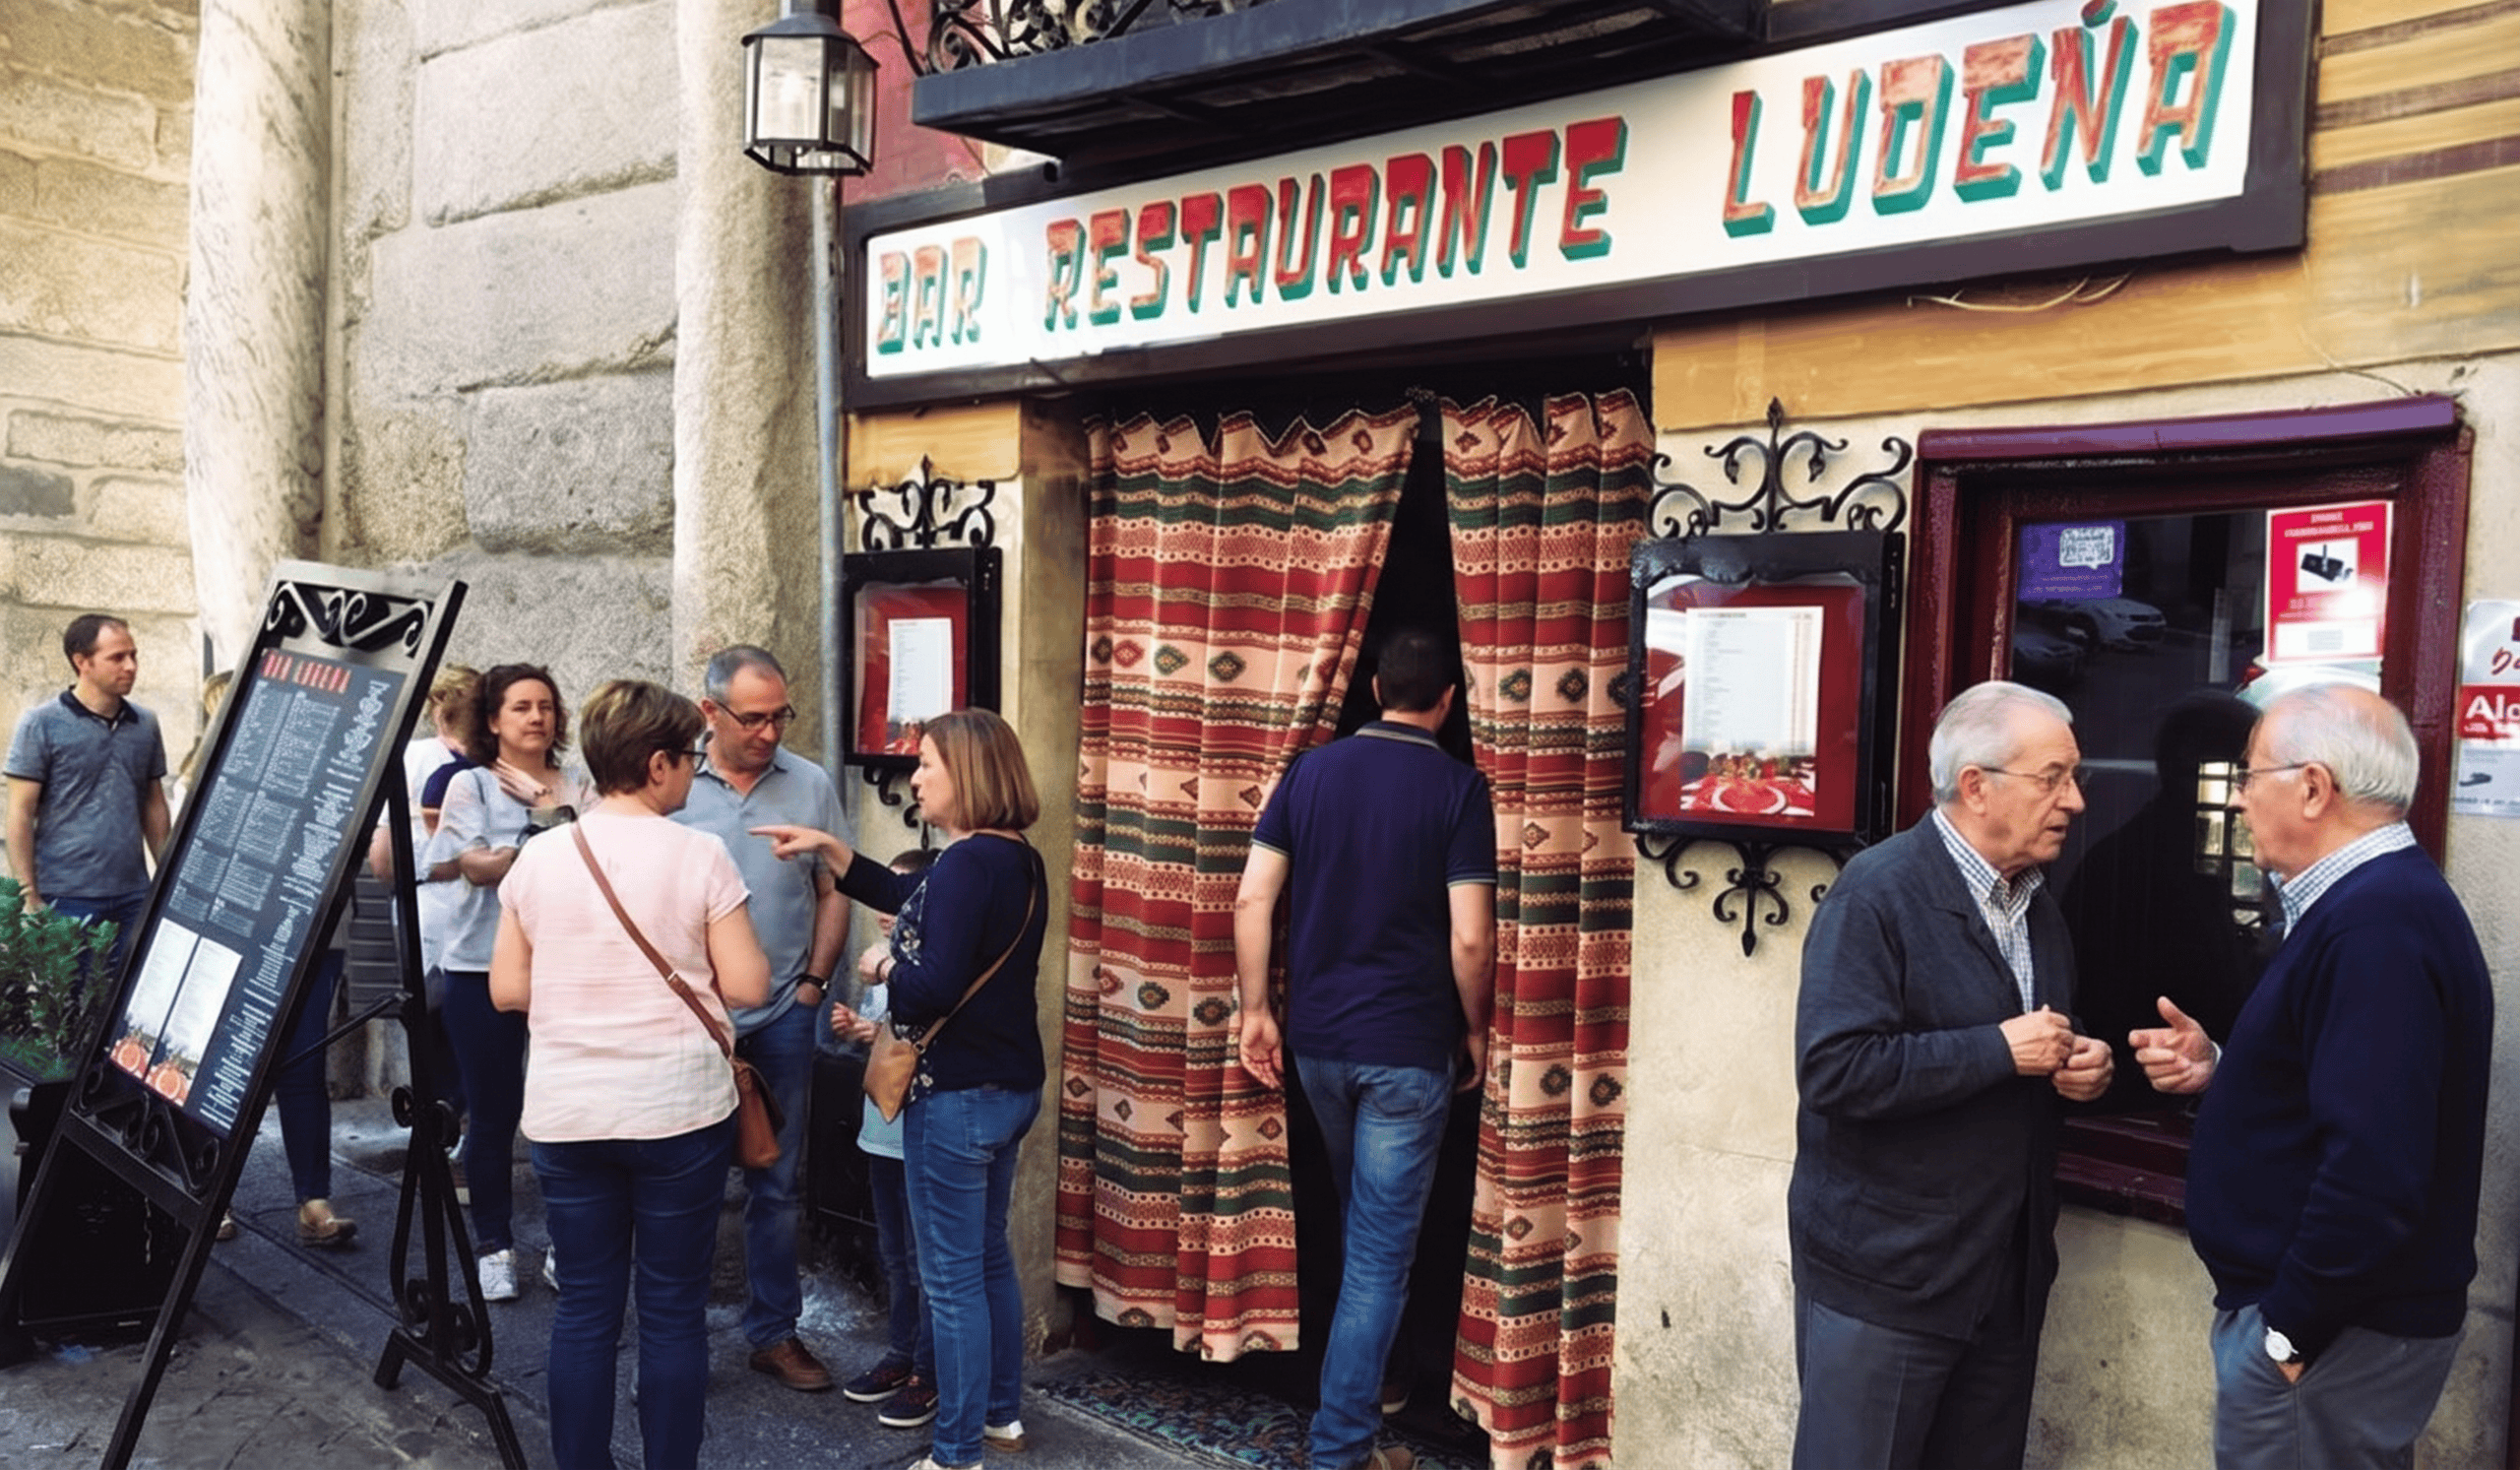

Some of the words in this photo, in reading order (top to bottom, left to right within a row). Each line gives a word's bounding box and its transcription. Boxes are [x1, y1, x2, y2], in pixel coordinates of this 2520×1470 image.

[877, 235, 987, 355] BAR
[1043, 114, 1627, 332] RESTAURANTE
[1722, 0, 2237, 239] LUDEÑA
